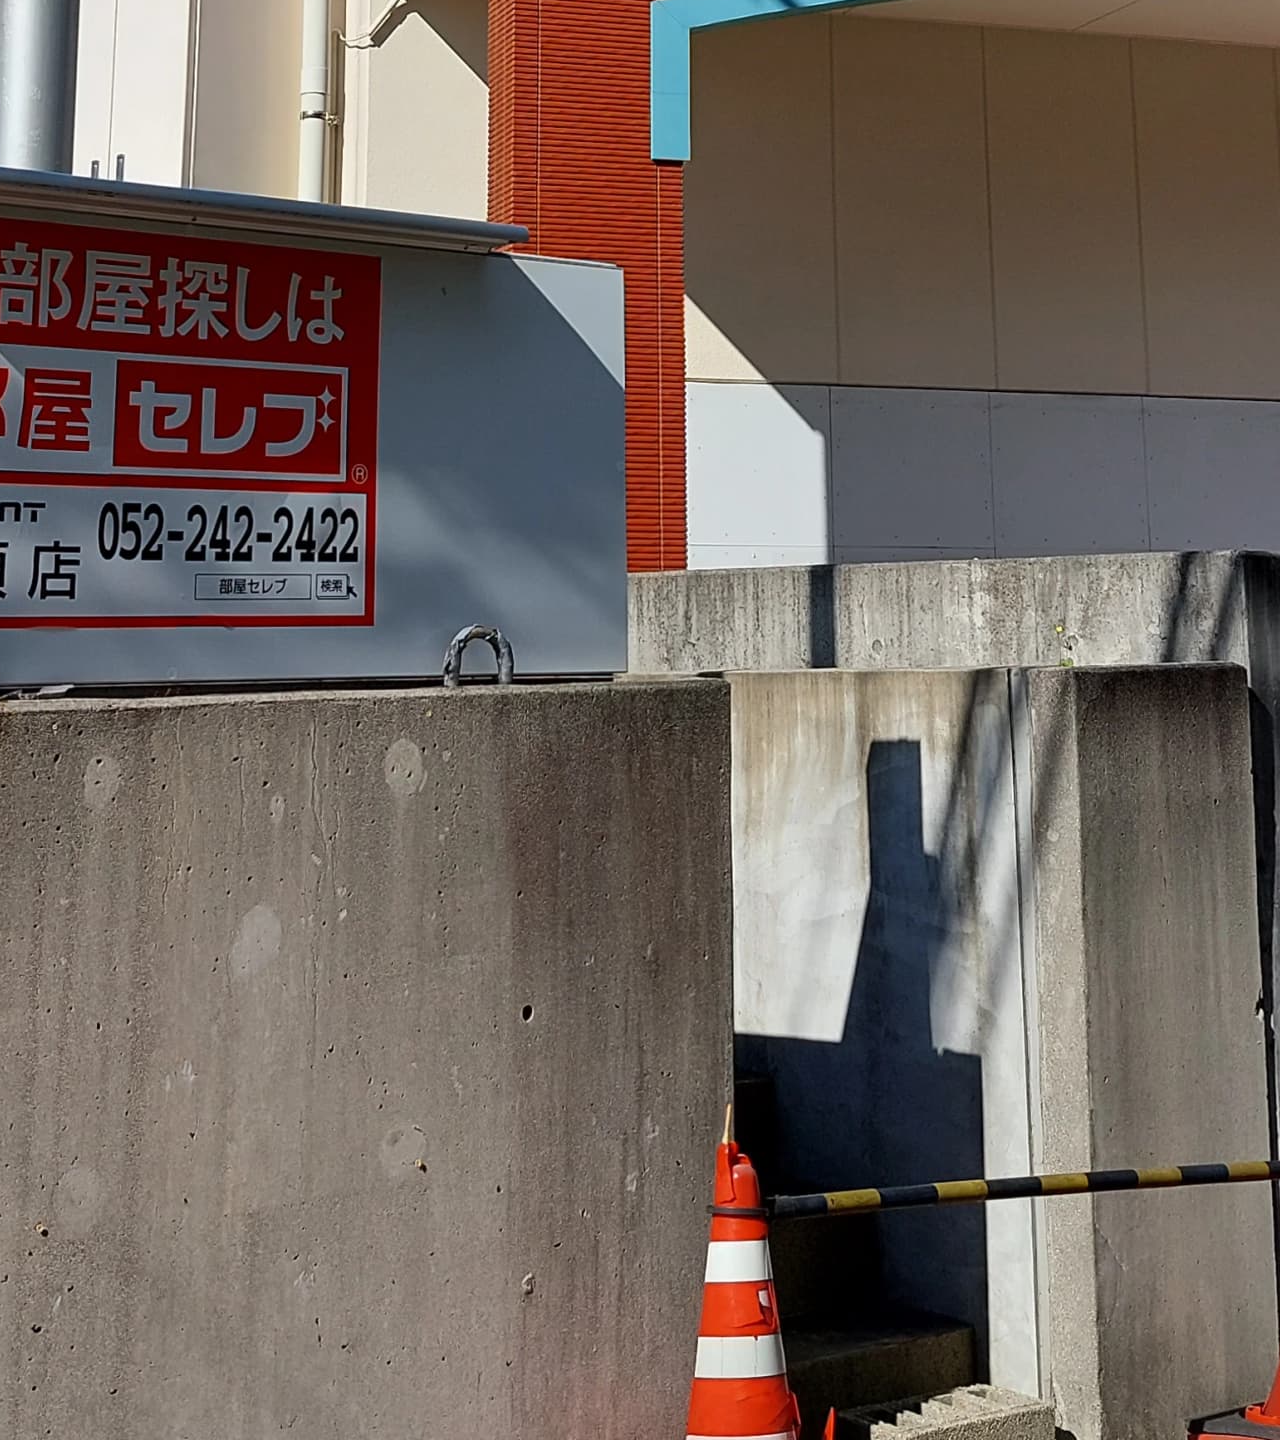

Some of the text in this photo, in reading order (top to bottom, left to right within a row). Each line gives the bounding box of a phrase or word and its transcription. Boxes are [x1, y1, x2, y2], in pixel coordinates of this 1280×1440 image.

[97, 501, 359, 563] 052-242-2422
[218, 578, 288, 595] 部屋セレブ
[320, 579, 344, 593] 検索
